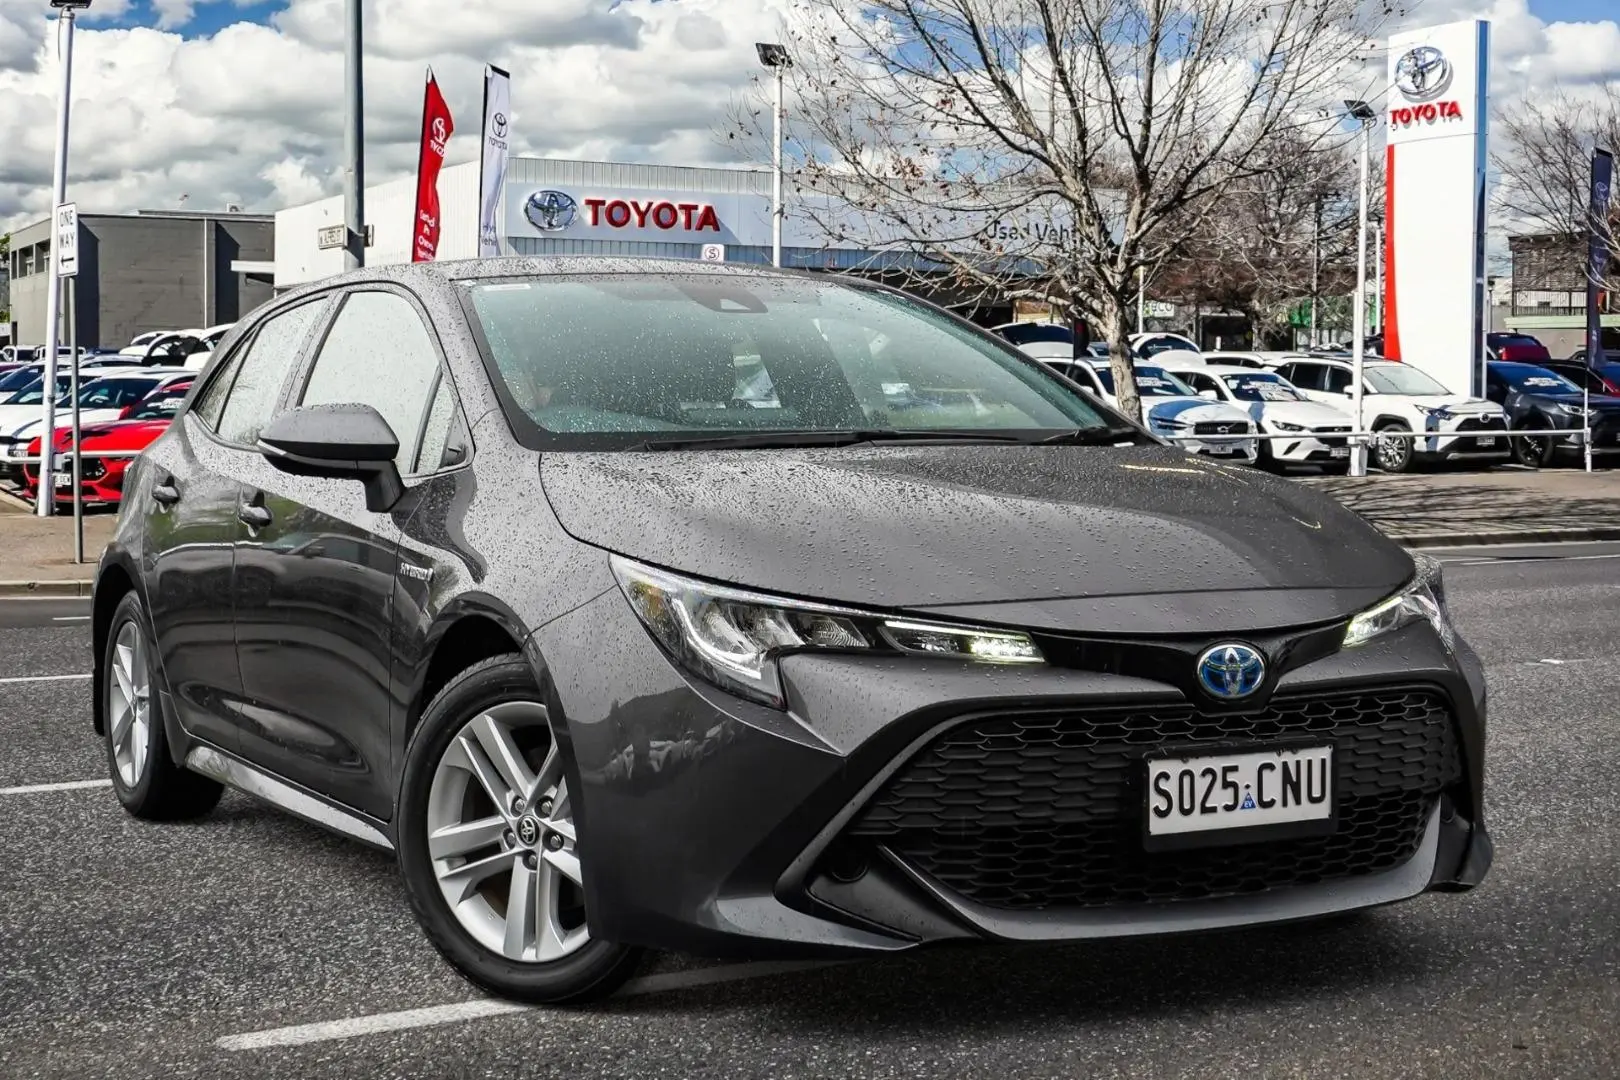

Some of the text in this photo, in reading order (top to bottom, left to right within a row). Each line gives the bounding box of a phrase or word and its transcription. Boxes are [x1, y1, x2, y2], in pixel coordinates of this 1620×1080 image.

[1390, 101, 1462, 124] TOYOTA
[60, 209, 75, 228] ONE
[584, 199, 720, 232] TOYOTA
[59, 231, 76, 249] WAY
